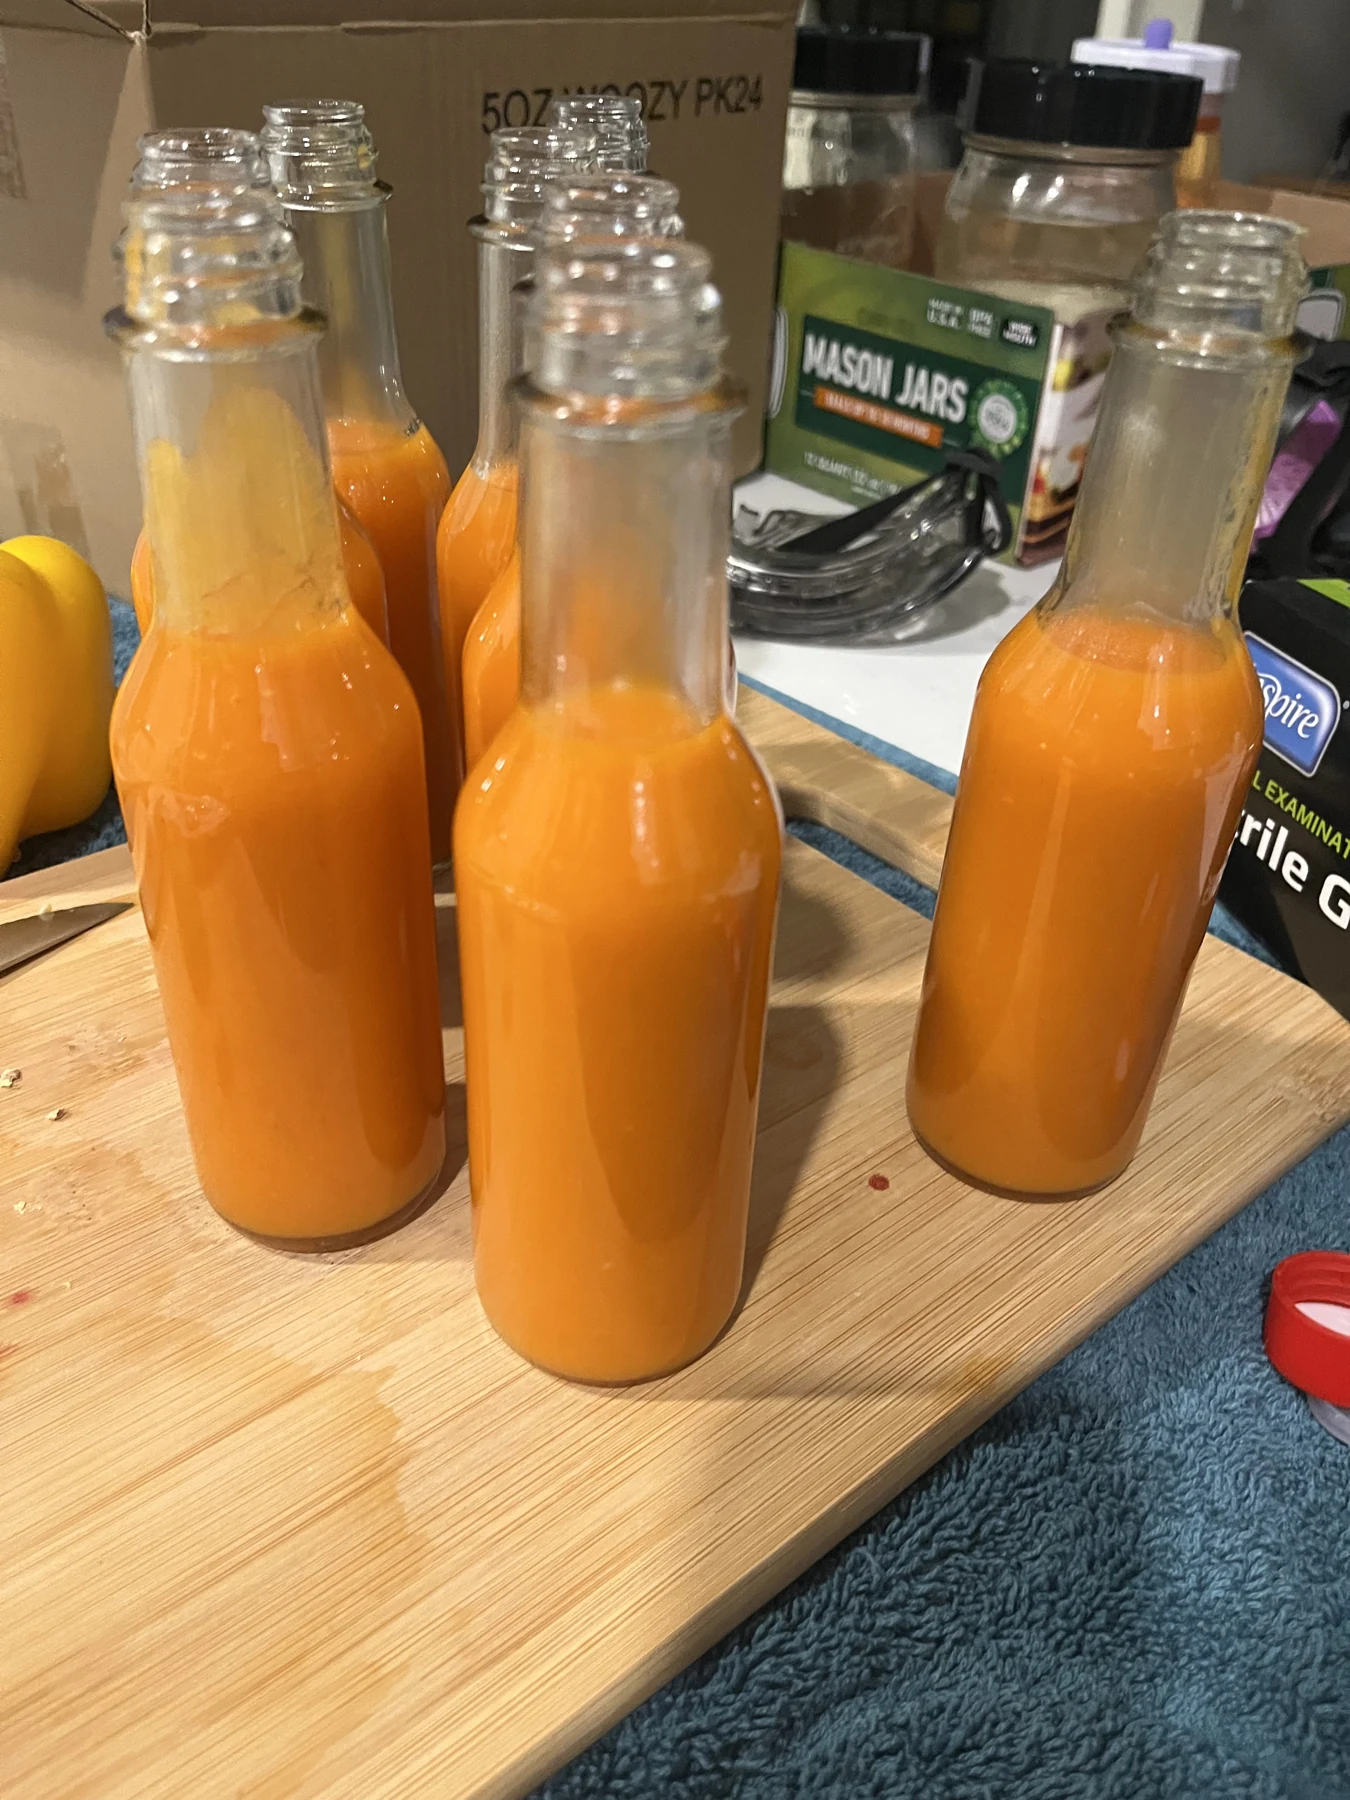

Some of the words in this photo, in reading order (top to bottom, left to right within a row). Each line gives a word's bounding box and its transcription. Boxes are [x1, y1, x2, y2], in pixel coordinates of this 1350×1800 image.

[695, 74, 763, 117] PK24
[802, 333, 894, 399] MASON
[895, 363, 969, 424] JARS
[1235, 809, 1309, 893] rile
